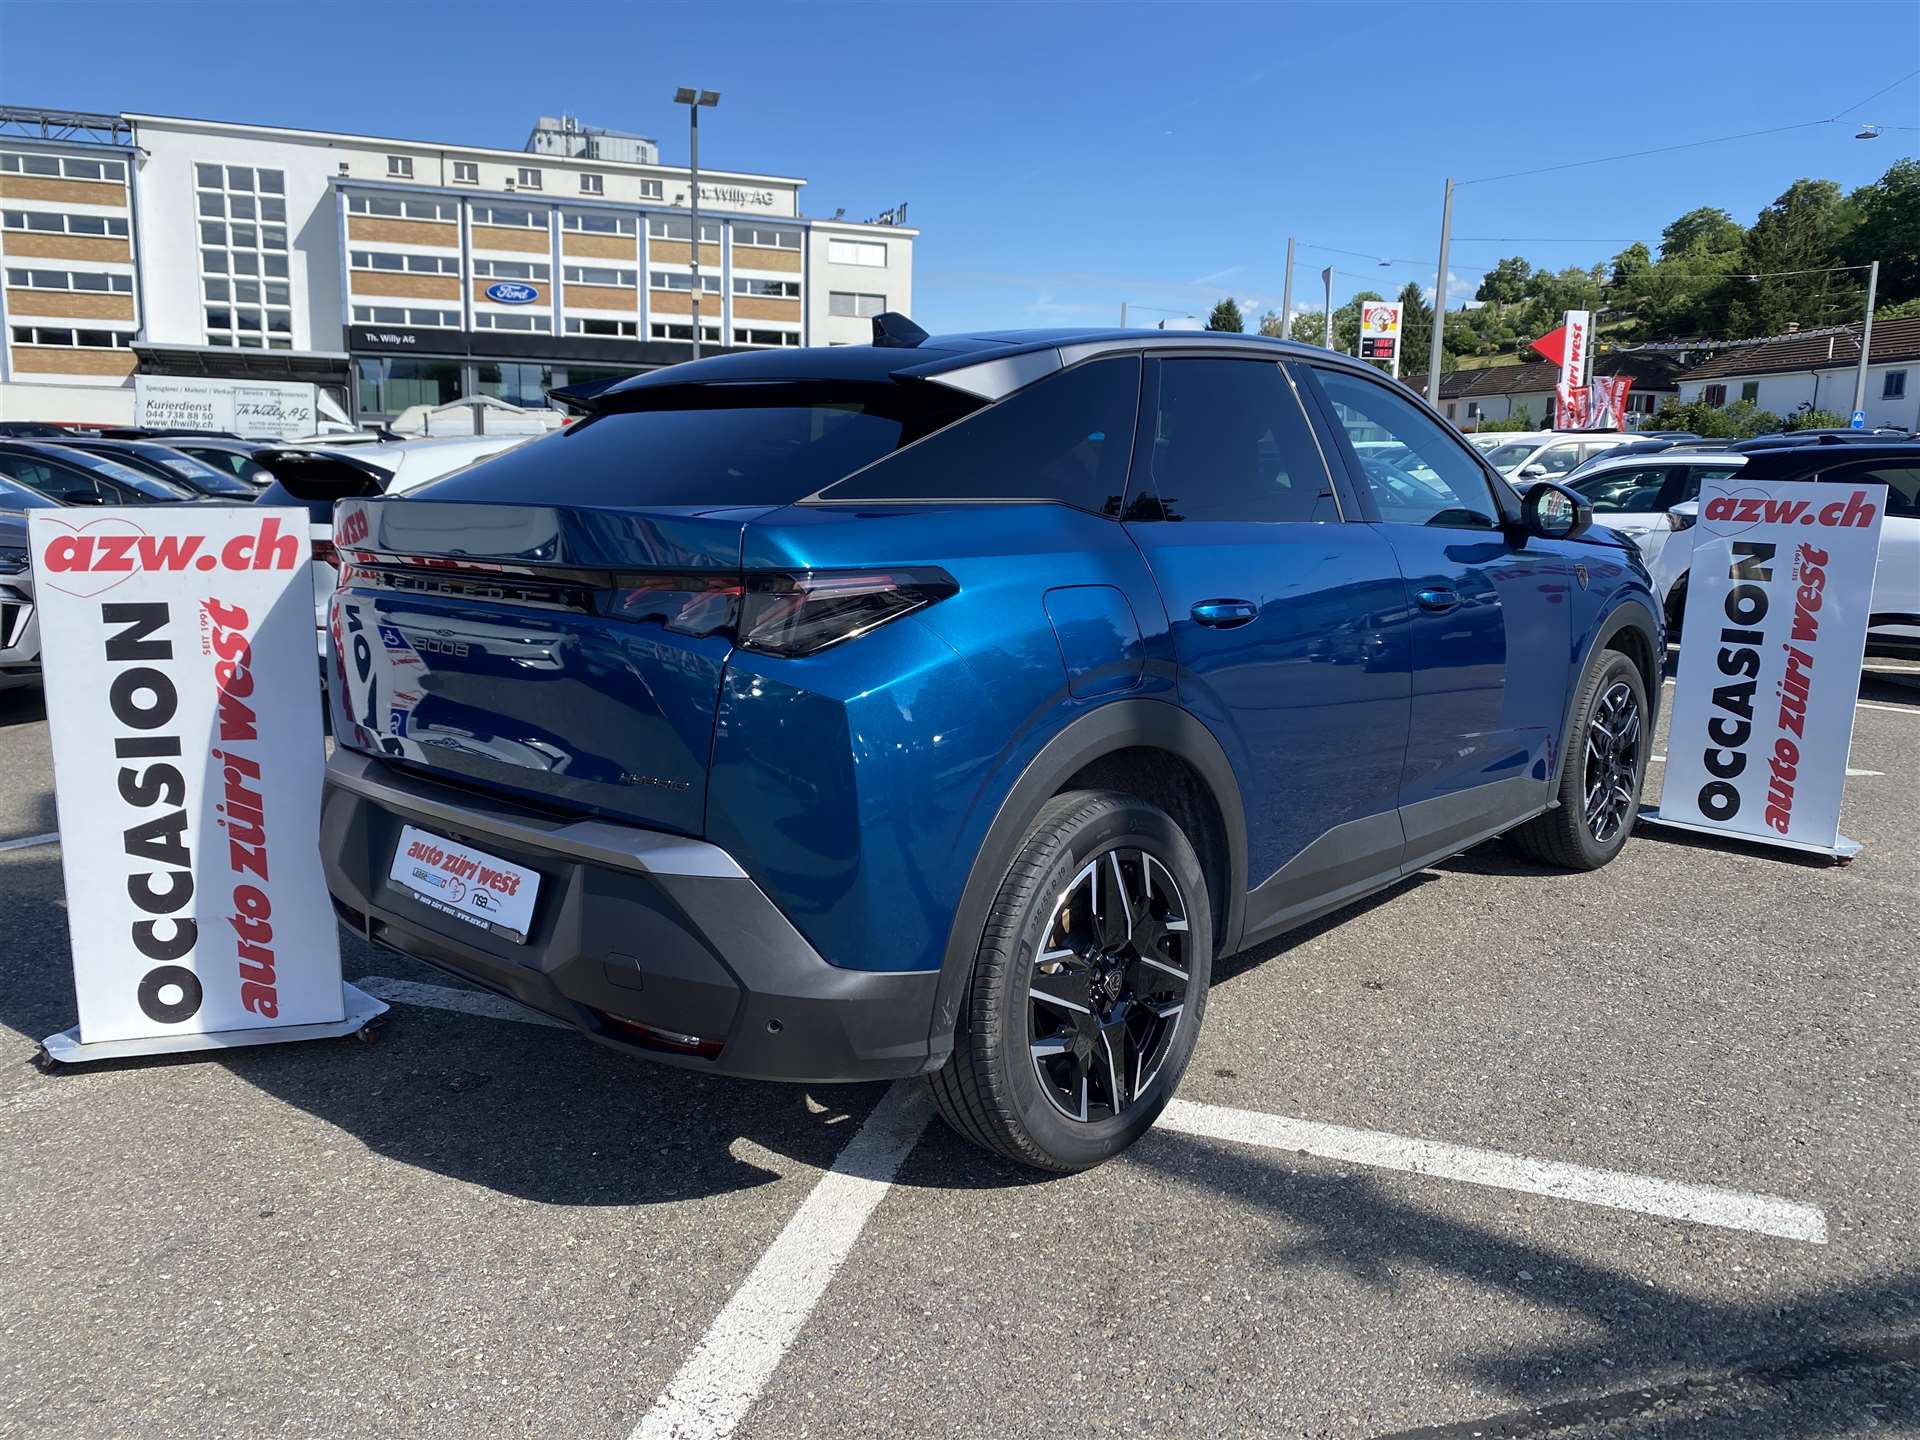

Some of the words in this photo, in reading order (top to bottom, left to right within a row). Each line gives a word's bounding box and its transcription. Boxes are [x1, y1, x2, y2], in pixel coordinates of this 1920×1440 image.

[714, 185, 746, 206] Willy
[750, 189, 774, 206] AG
[497, 285, 528, 300] Ford
[365, 333, 379, 343] Th.
[380, 334, 401, 345] Willy
[402, 336, 416, 344] AG
[1571, 323, 1583, 362] west
[146, 400, 212, 412] Kurierdienst
[146, 418, 213, 430] www.thwilly.ch
[167, 411, 184, 419] 738
[201, 412, 213, 420] 50
[252, 404, 286, 420] Willy
[1704, 491, 1876, 528] azw.ch
[44, 518, 299, 572] azw.ch
[1791, 542, 1829, 642] west
[200, 609, 209, 631] 1991
[202, 636, 211, 656] SEIT
[414, 637, 470, 657] 3008
[200, 597, 257, 741] west
[1698, 541, 1776, 821] OCCASION
[1776, 643, 1814, 740] züri
[1765, 738, 1801, 835] auto
[102, 601, 203, 1024] OCCASION
[211, 748, 271, 883] züri
[407, 841, 444, 866] auto
[440, 854, 481, 880] züri
[477, 865, 521, 896] west
[226, 884, 278, 1019] auto
